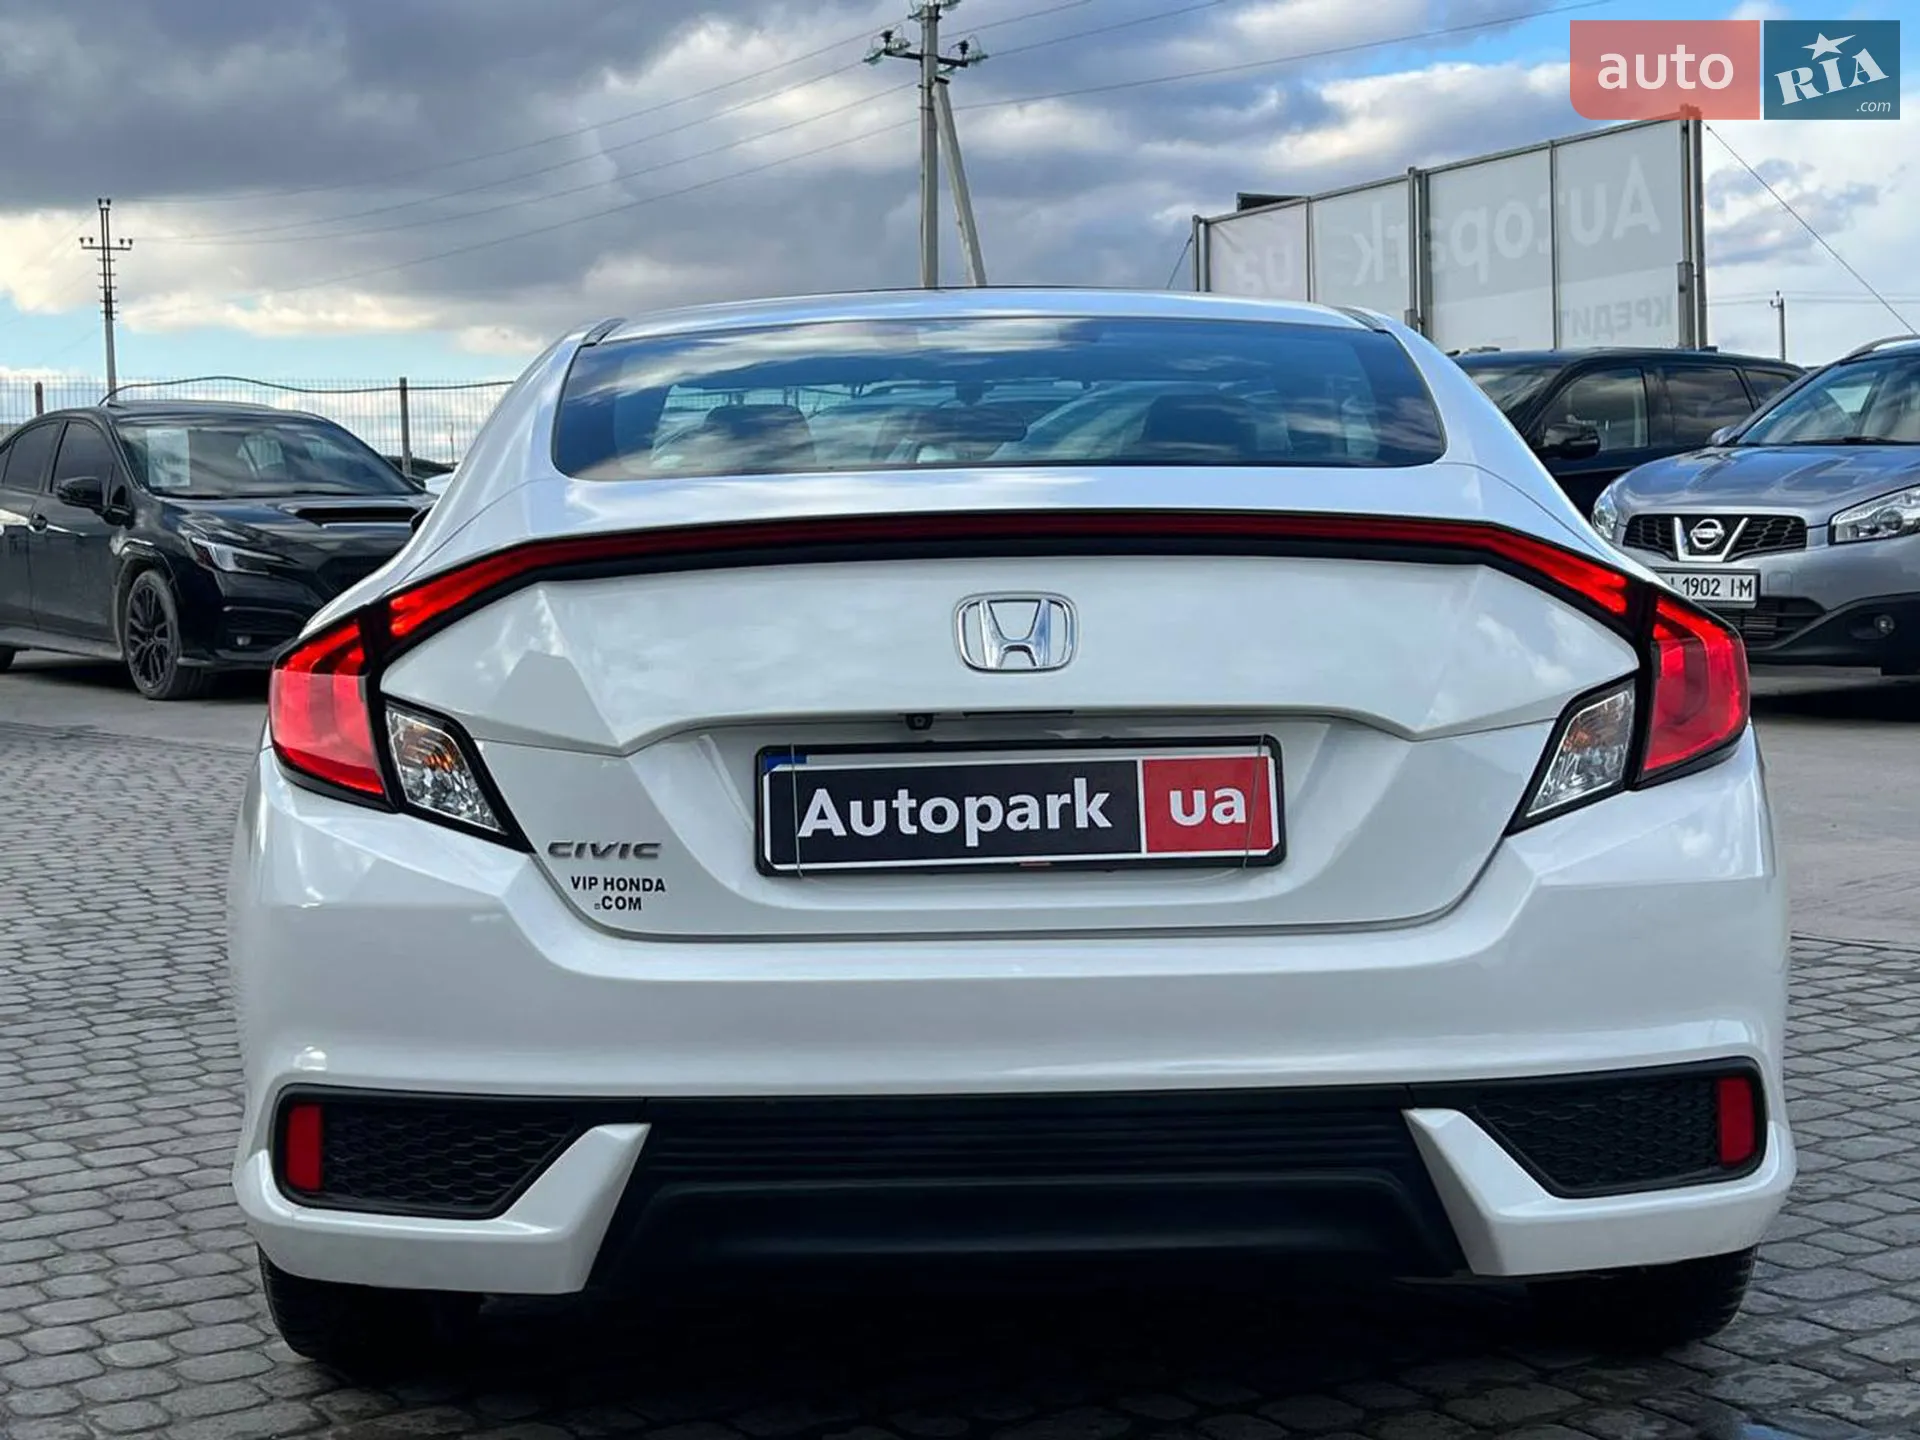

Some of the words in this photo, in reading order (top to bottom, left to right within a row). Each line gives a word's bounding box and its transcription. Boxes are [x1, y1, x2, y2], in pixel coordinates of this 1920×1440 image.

[1682, 577, 1721, 597] 1902
[797, 777, 1112, 848] Autopark
[1169, 785, 1246, 827] ua
[548, 842, 662, 859] CIVIC
[571, 876, 598, 891] VIP
[603, 877, 666, 893] HONDA
